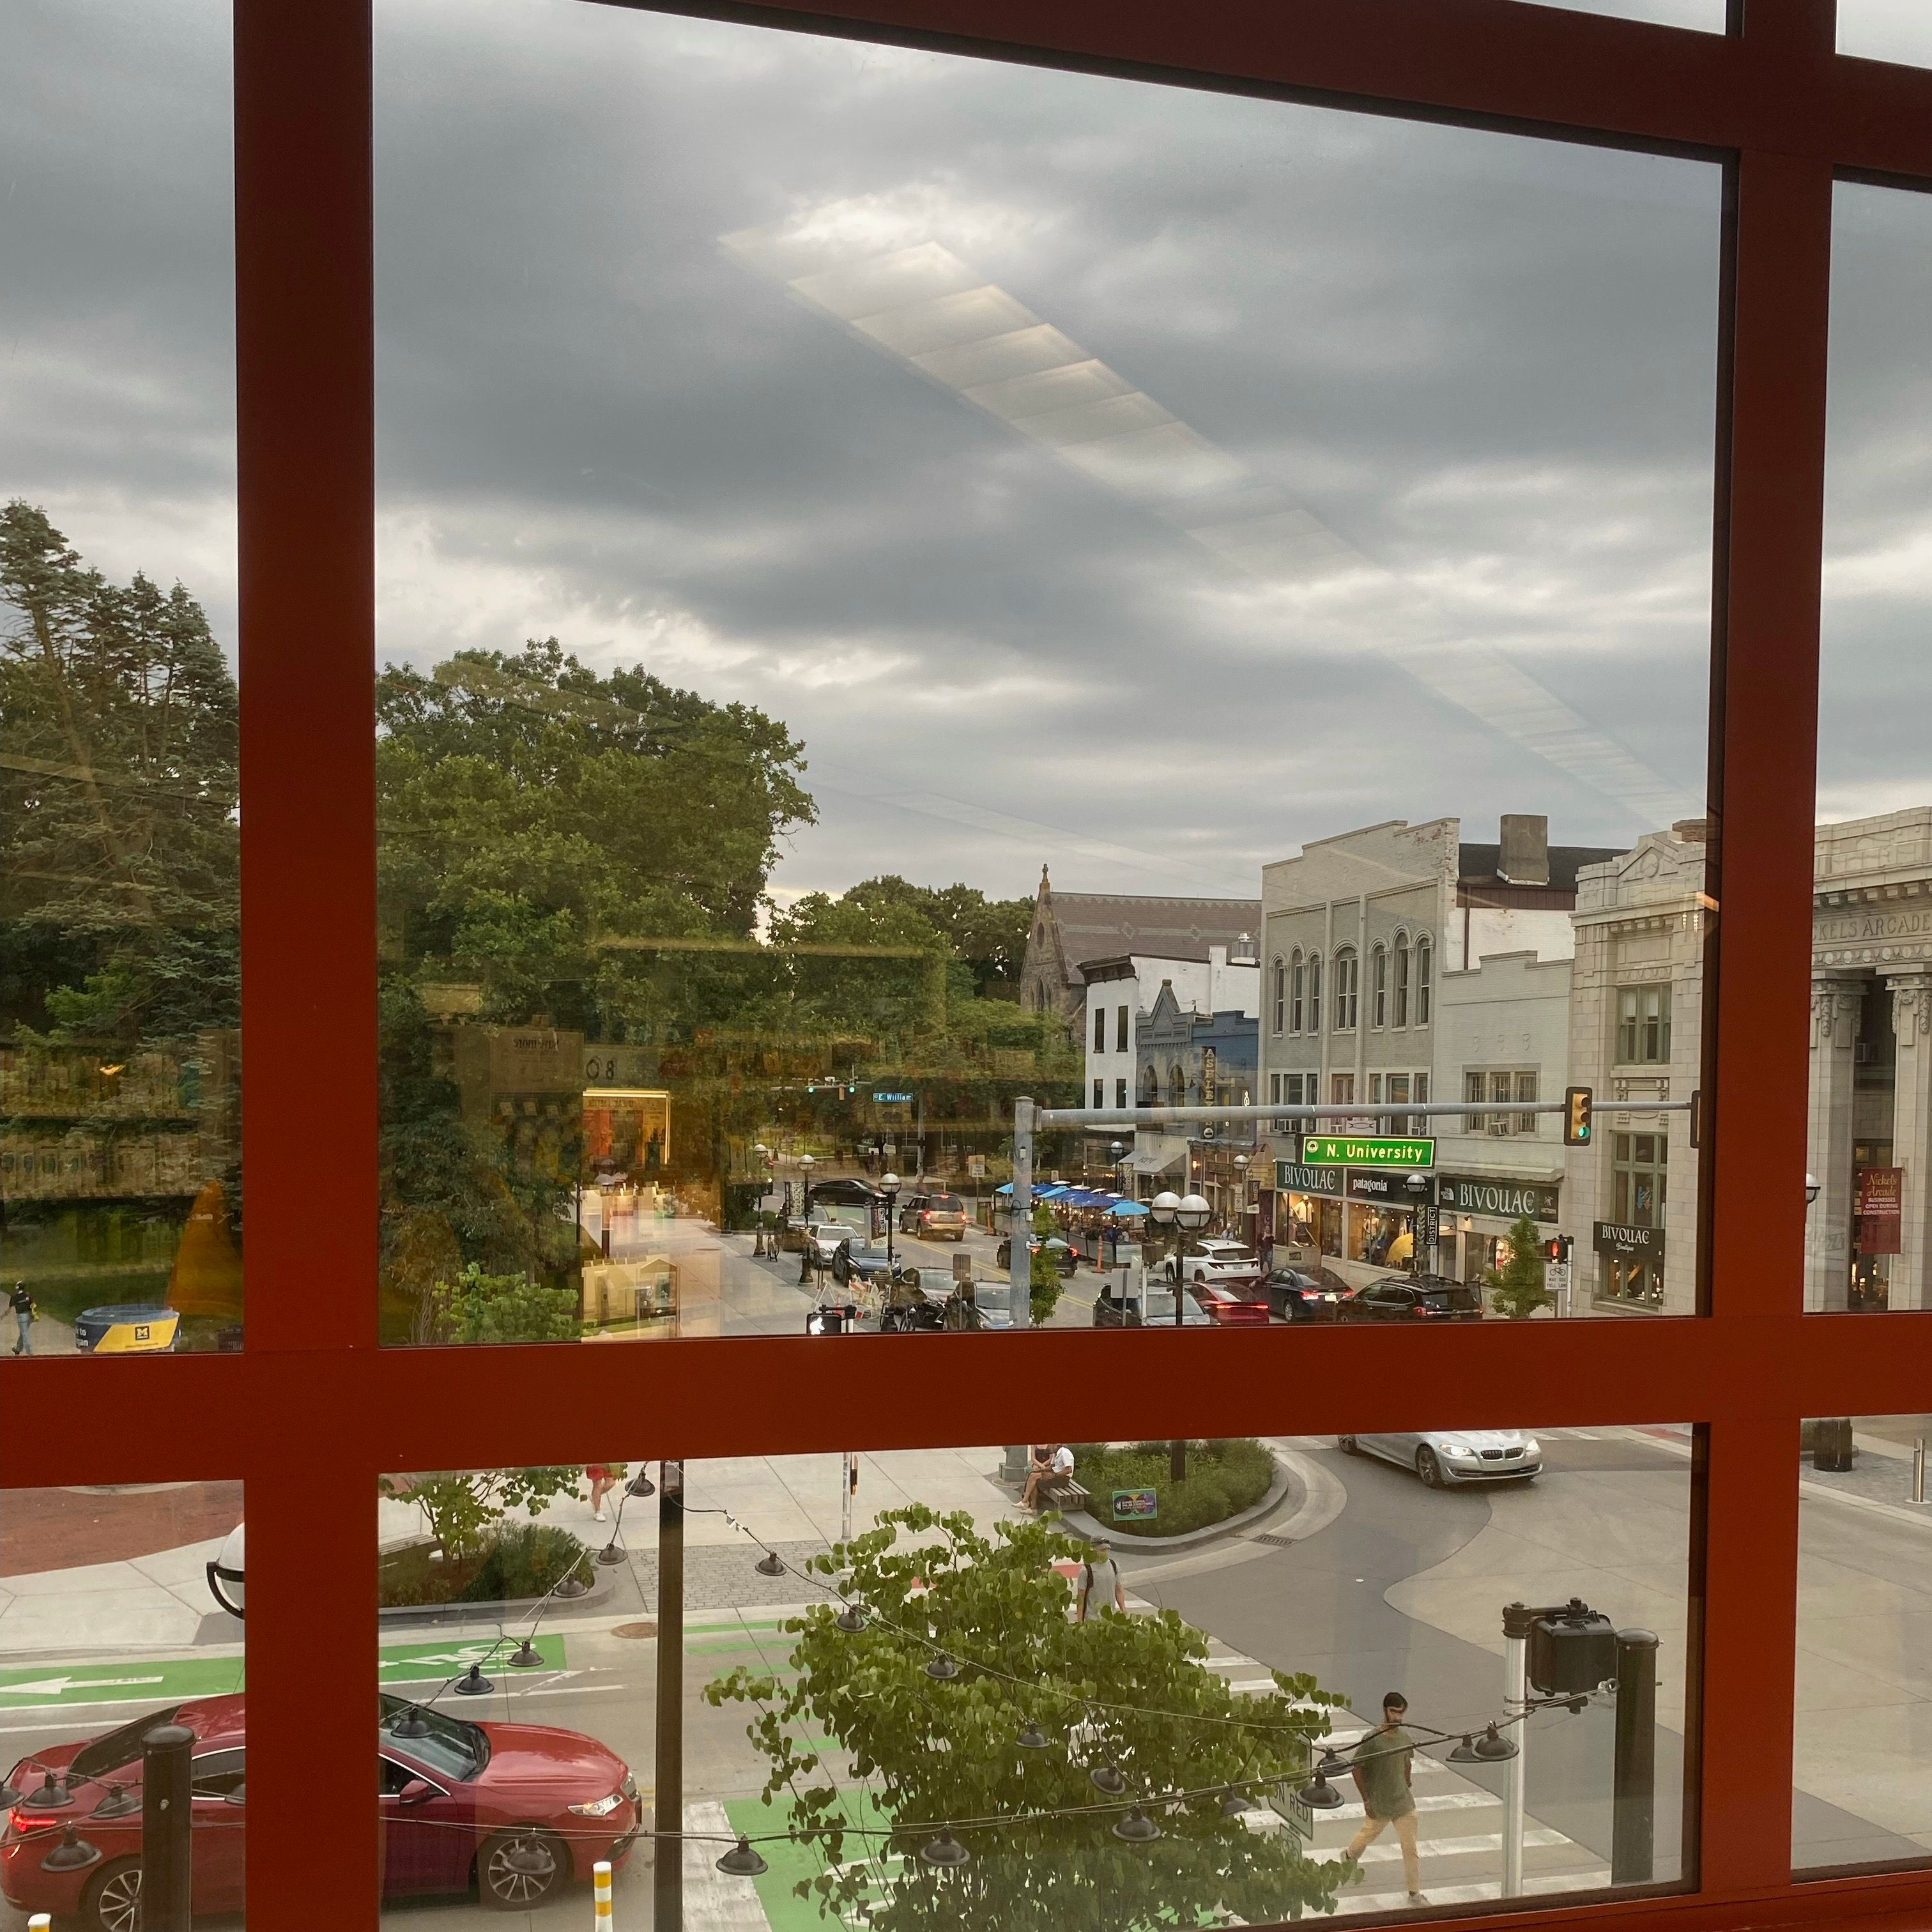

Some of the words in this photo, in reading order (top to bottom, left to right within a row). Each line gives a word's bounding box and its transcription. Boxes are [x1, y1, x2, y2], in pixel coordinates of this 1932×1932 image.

[1862, 914, 1931, 937] ARCADE
[1205, 1048, 1215, 1126] ASHLEYS
[1326, 1144, 1340, 1158] N.
[1346, 1144, 1423, 1163] University
[1284, 1165, 1336, 1190] BIVOUAC
[1353, 1178, 1388, 1193] patagonia
[1866, 1173, 1897, 1186] Nickels
[1459, 1183, 1535, 1215] BIVOUAC
[1866, 1185, 1896, 1197] Arcade
[1428, 1208, 1436, 1243] DISTRICT
[1602, 1225, 1650, 1245] BIVOUAC
[1289, 1793, 1308, 1823] RED
